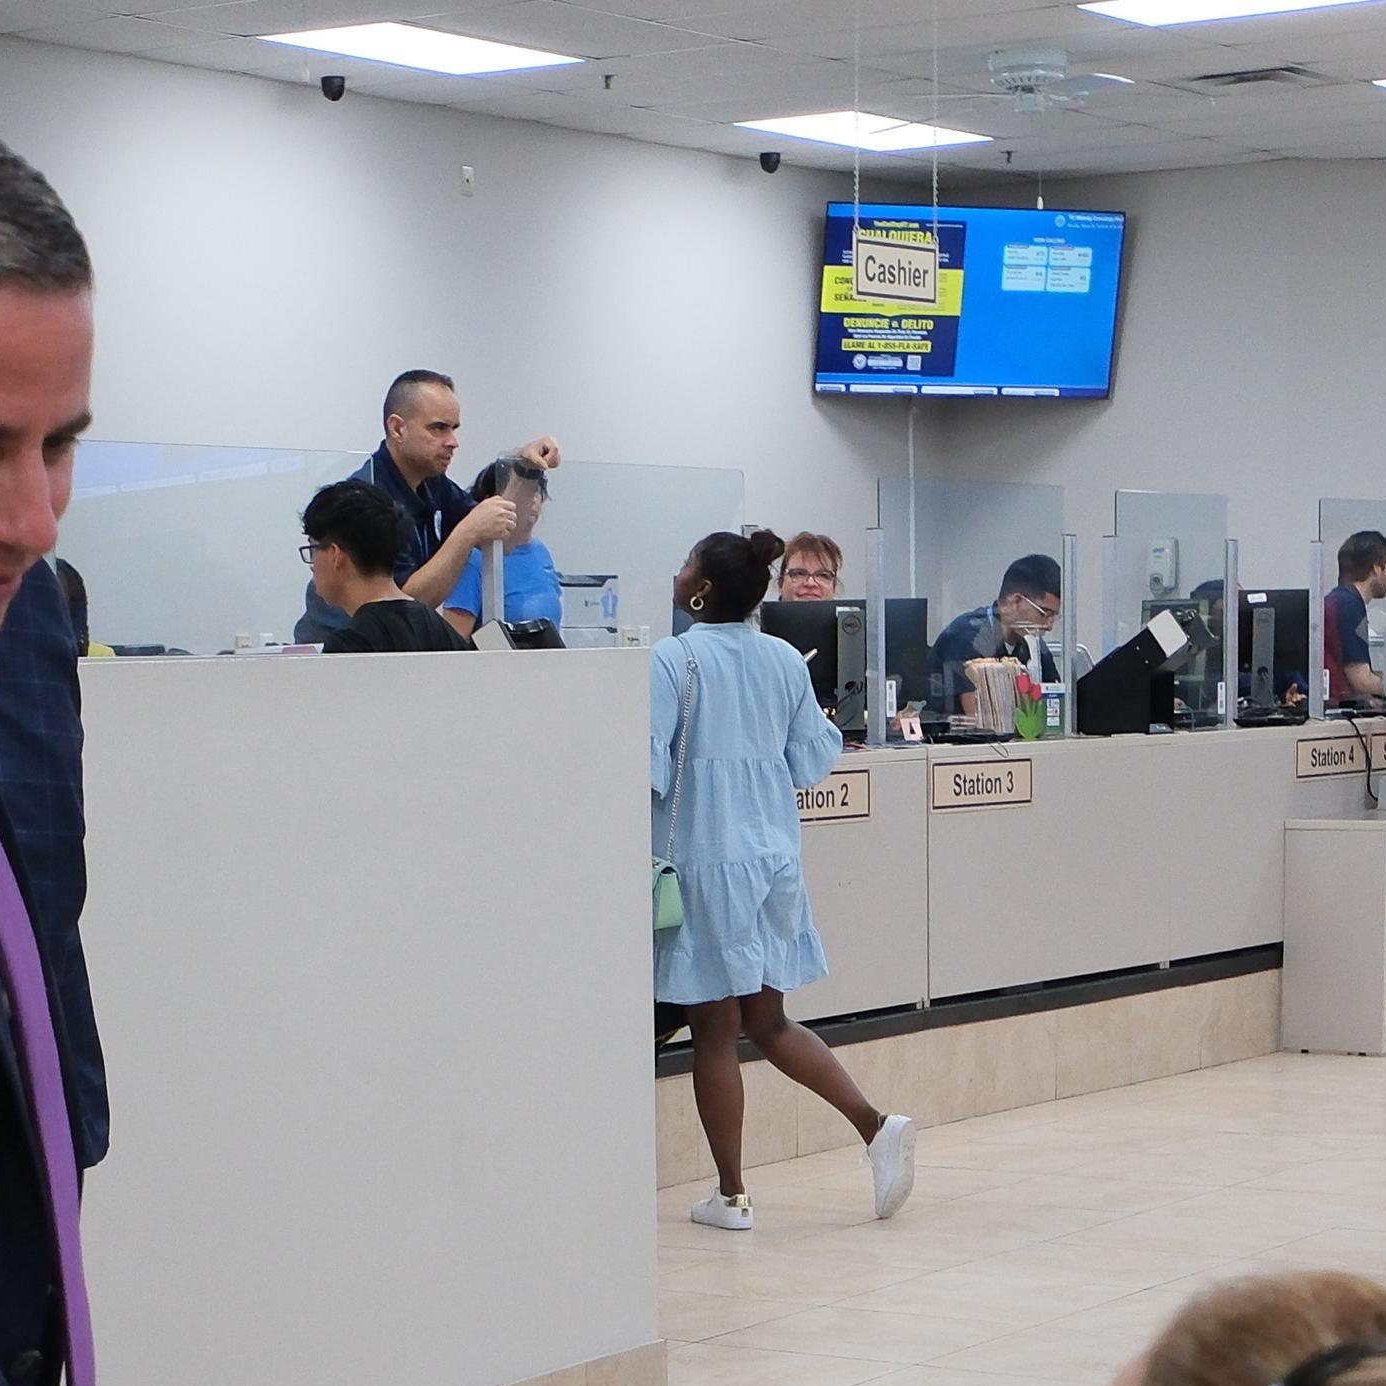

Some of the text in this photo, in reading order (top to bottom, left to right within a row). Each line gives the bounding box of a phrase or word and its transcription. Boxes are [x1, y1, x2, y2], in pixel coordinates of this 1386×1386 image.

[865, 255, 929, 288] Cashier
[901, 319, 934, 330] DELITO
[1311, 745, 1354, 768] Station 4
[796, 783, 849, 810] ation 2
[952, 770, 1014, 797] Station 3
